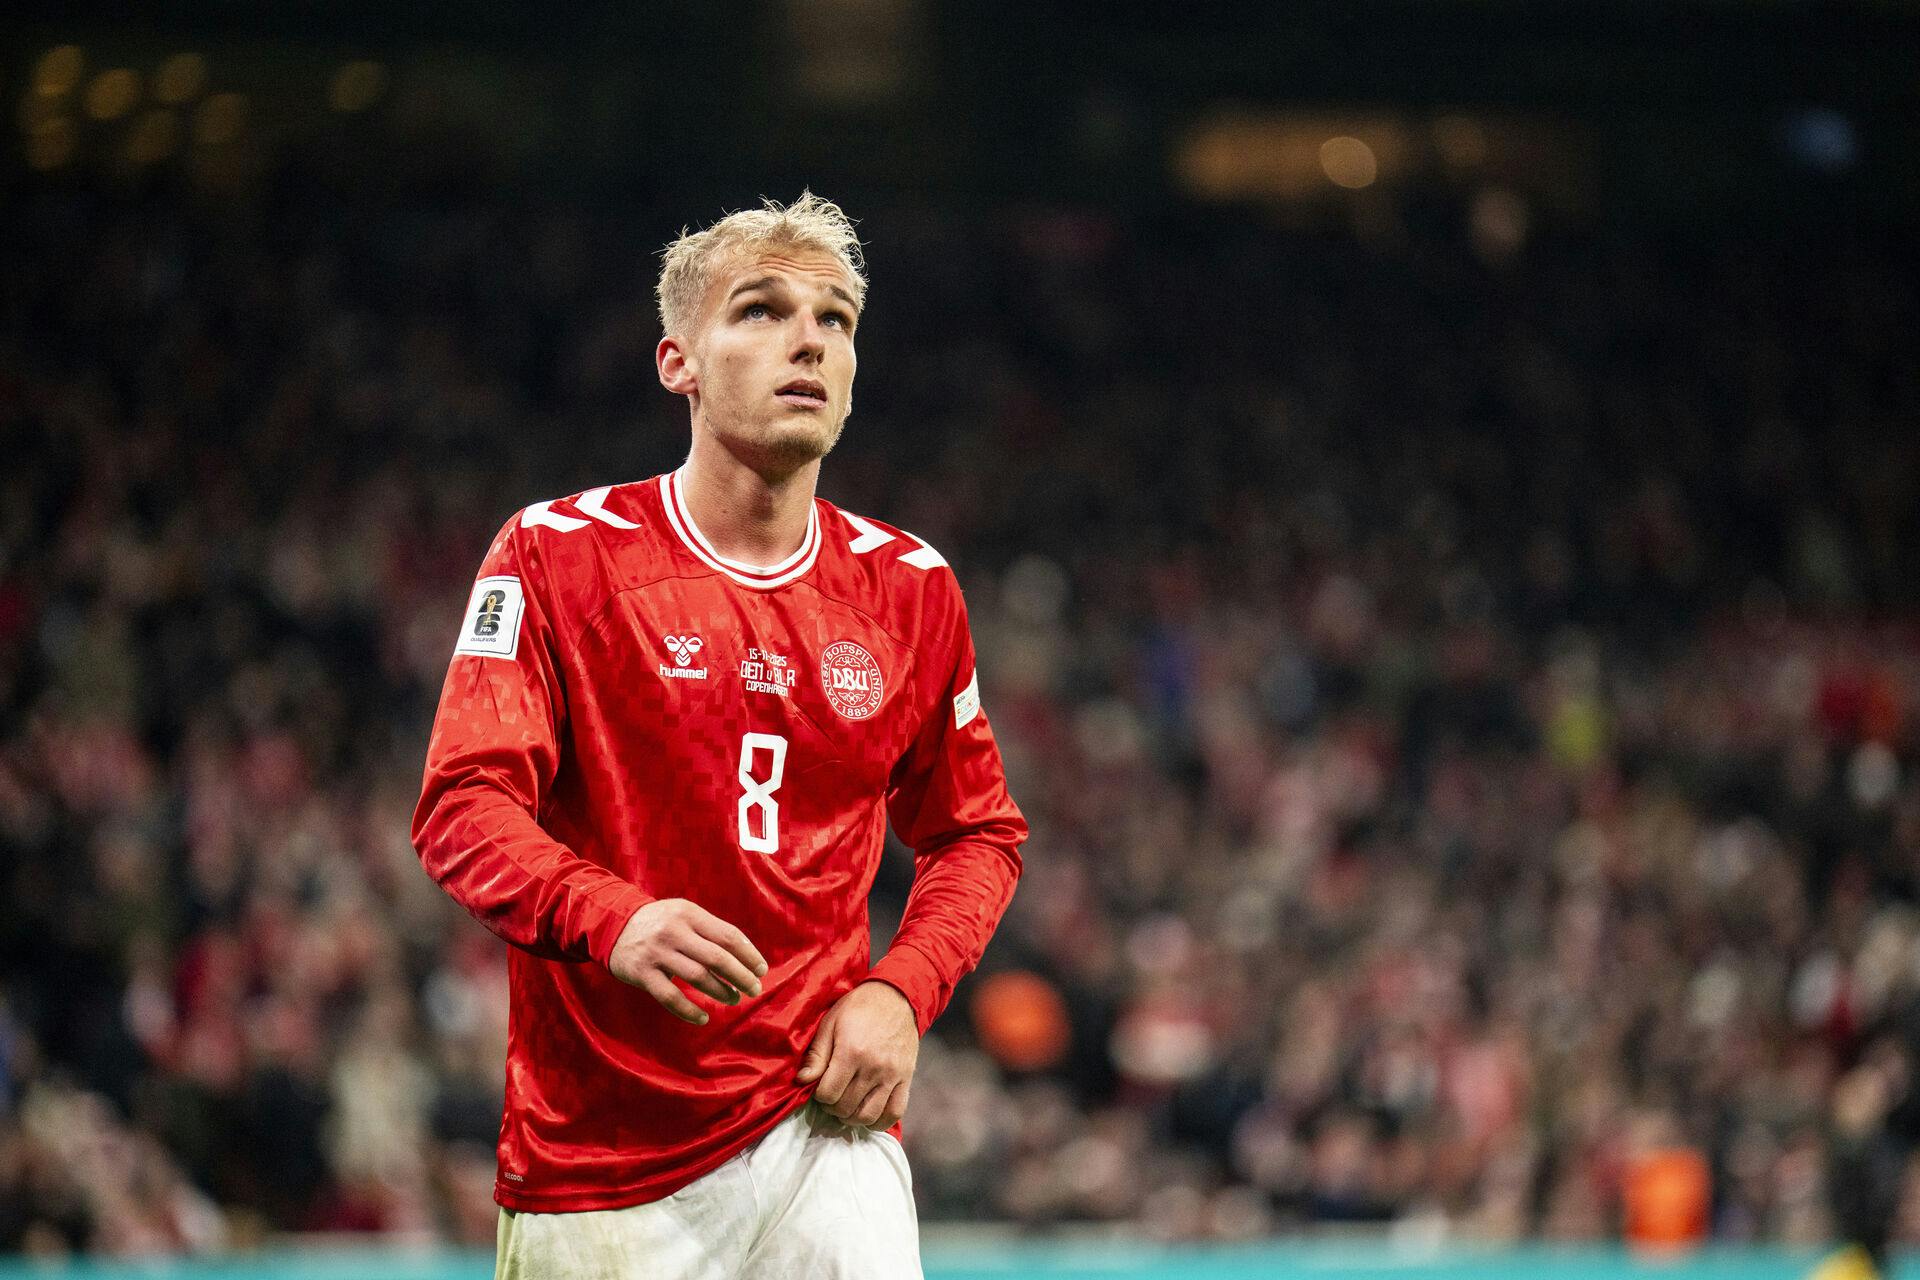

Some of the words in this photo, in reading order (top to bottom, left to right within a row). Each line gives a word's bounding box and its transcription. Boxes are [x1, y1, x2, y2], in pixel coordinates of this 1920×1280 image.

[659, 663, 708, 680] hummel
[740, 660, 764, 680] DEN
[773, 667, 796, 687] BLR
[831, 667, 870, 691] DBU
[822, 661, 839, 707] DANSK
[868, 668, 881, 708] UNION
[842, 705, 868, 717] 1889
[738, 731, 788, 854] 8
